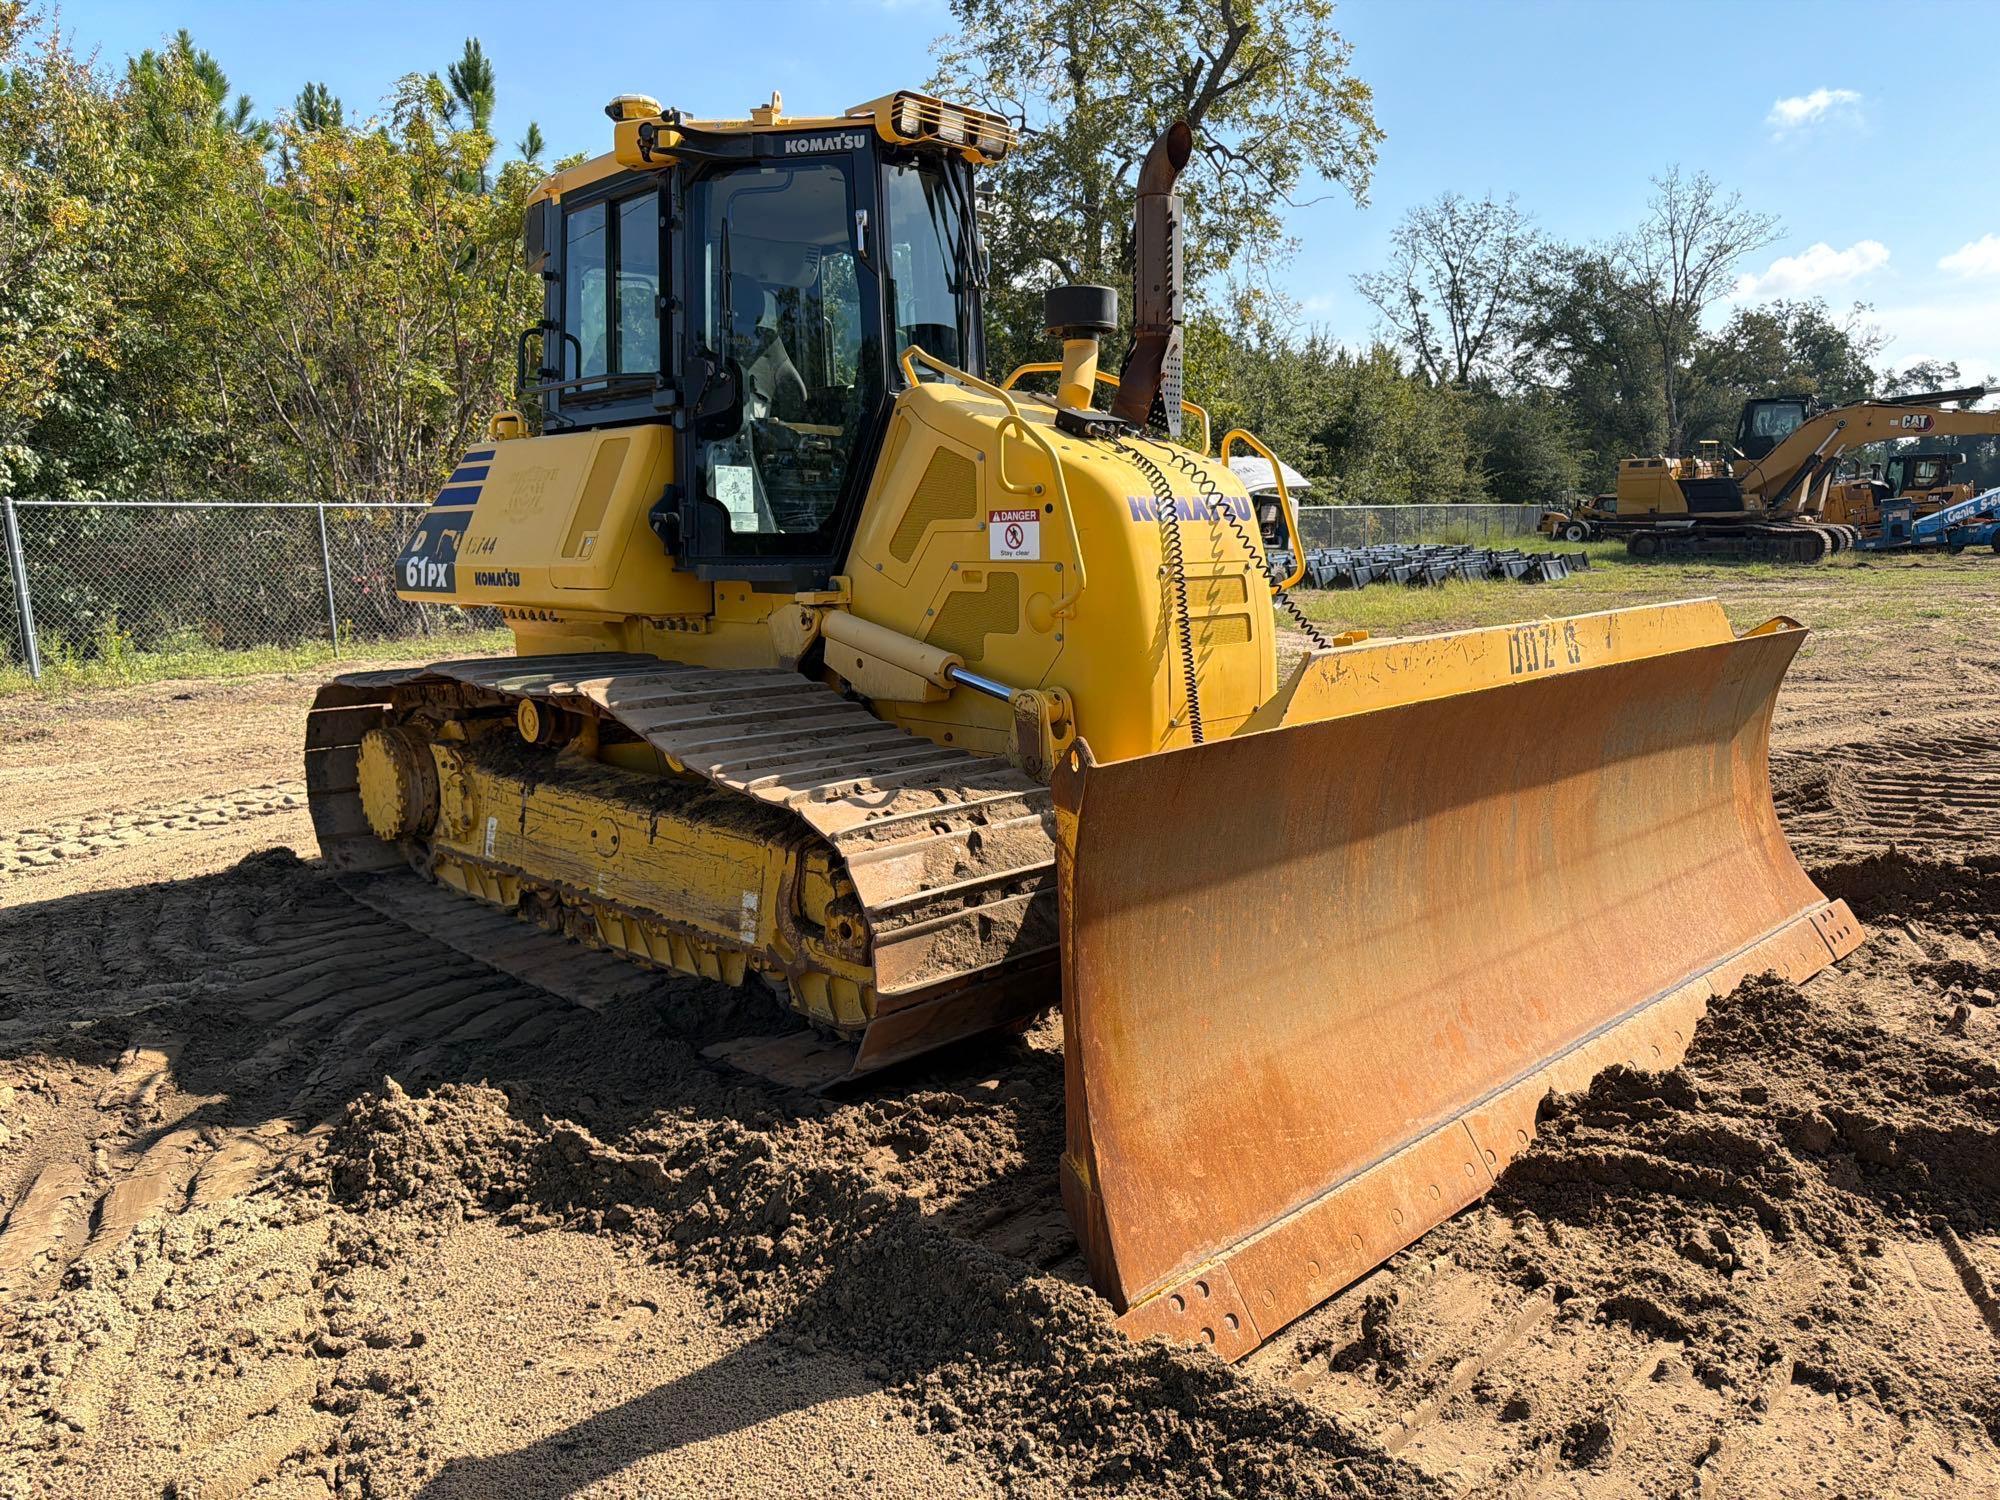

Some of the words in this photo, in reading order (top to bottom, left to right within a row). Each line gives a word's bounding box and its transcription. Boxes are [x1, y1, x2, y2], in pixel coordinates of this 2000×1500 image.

[785, 133, 866, 153] KOMATSU
[1901, 415, 1928, 429] CAT
[1001, 510, 1037, 521] DANGER
[1947, 505, 1976, 523] Genie
[1000, 549, 1014, 558] Stay
[406, 556, 448, 587] 61PX
[474, 567, 520, 588] KOMATSU
